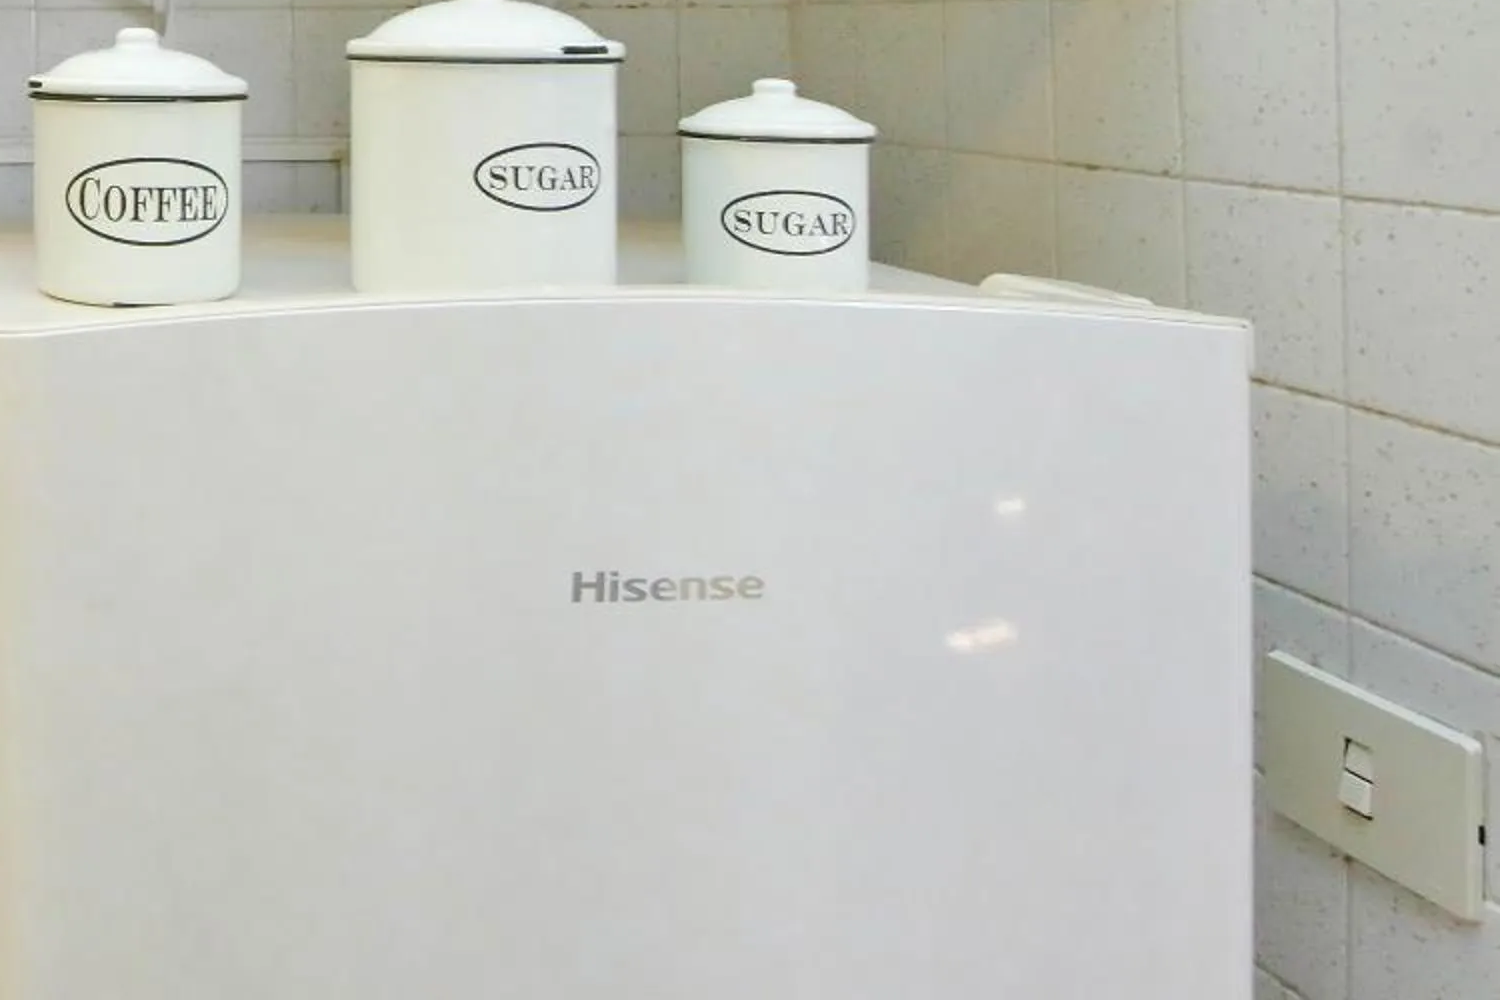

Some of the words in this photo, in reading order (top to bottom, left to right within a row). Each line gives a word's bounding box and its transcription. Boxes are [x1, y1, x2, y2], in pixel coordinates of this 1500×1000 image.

[489, 165, 594, 190] SUGAR
[733, 209, 848, 236] SUGAR
[572, 571, 765, 602] Hisense
